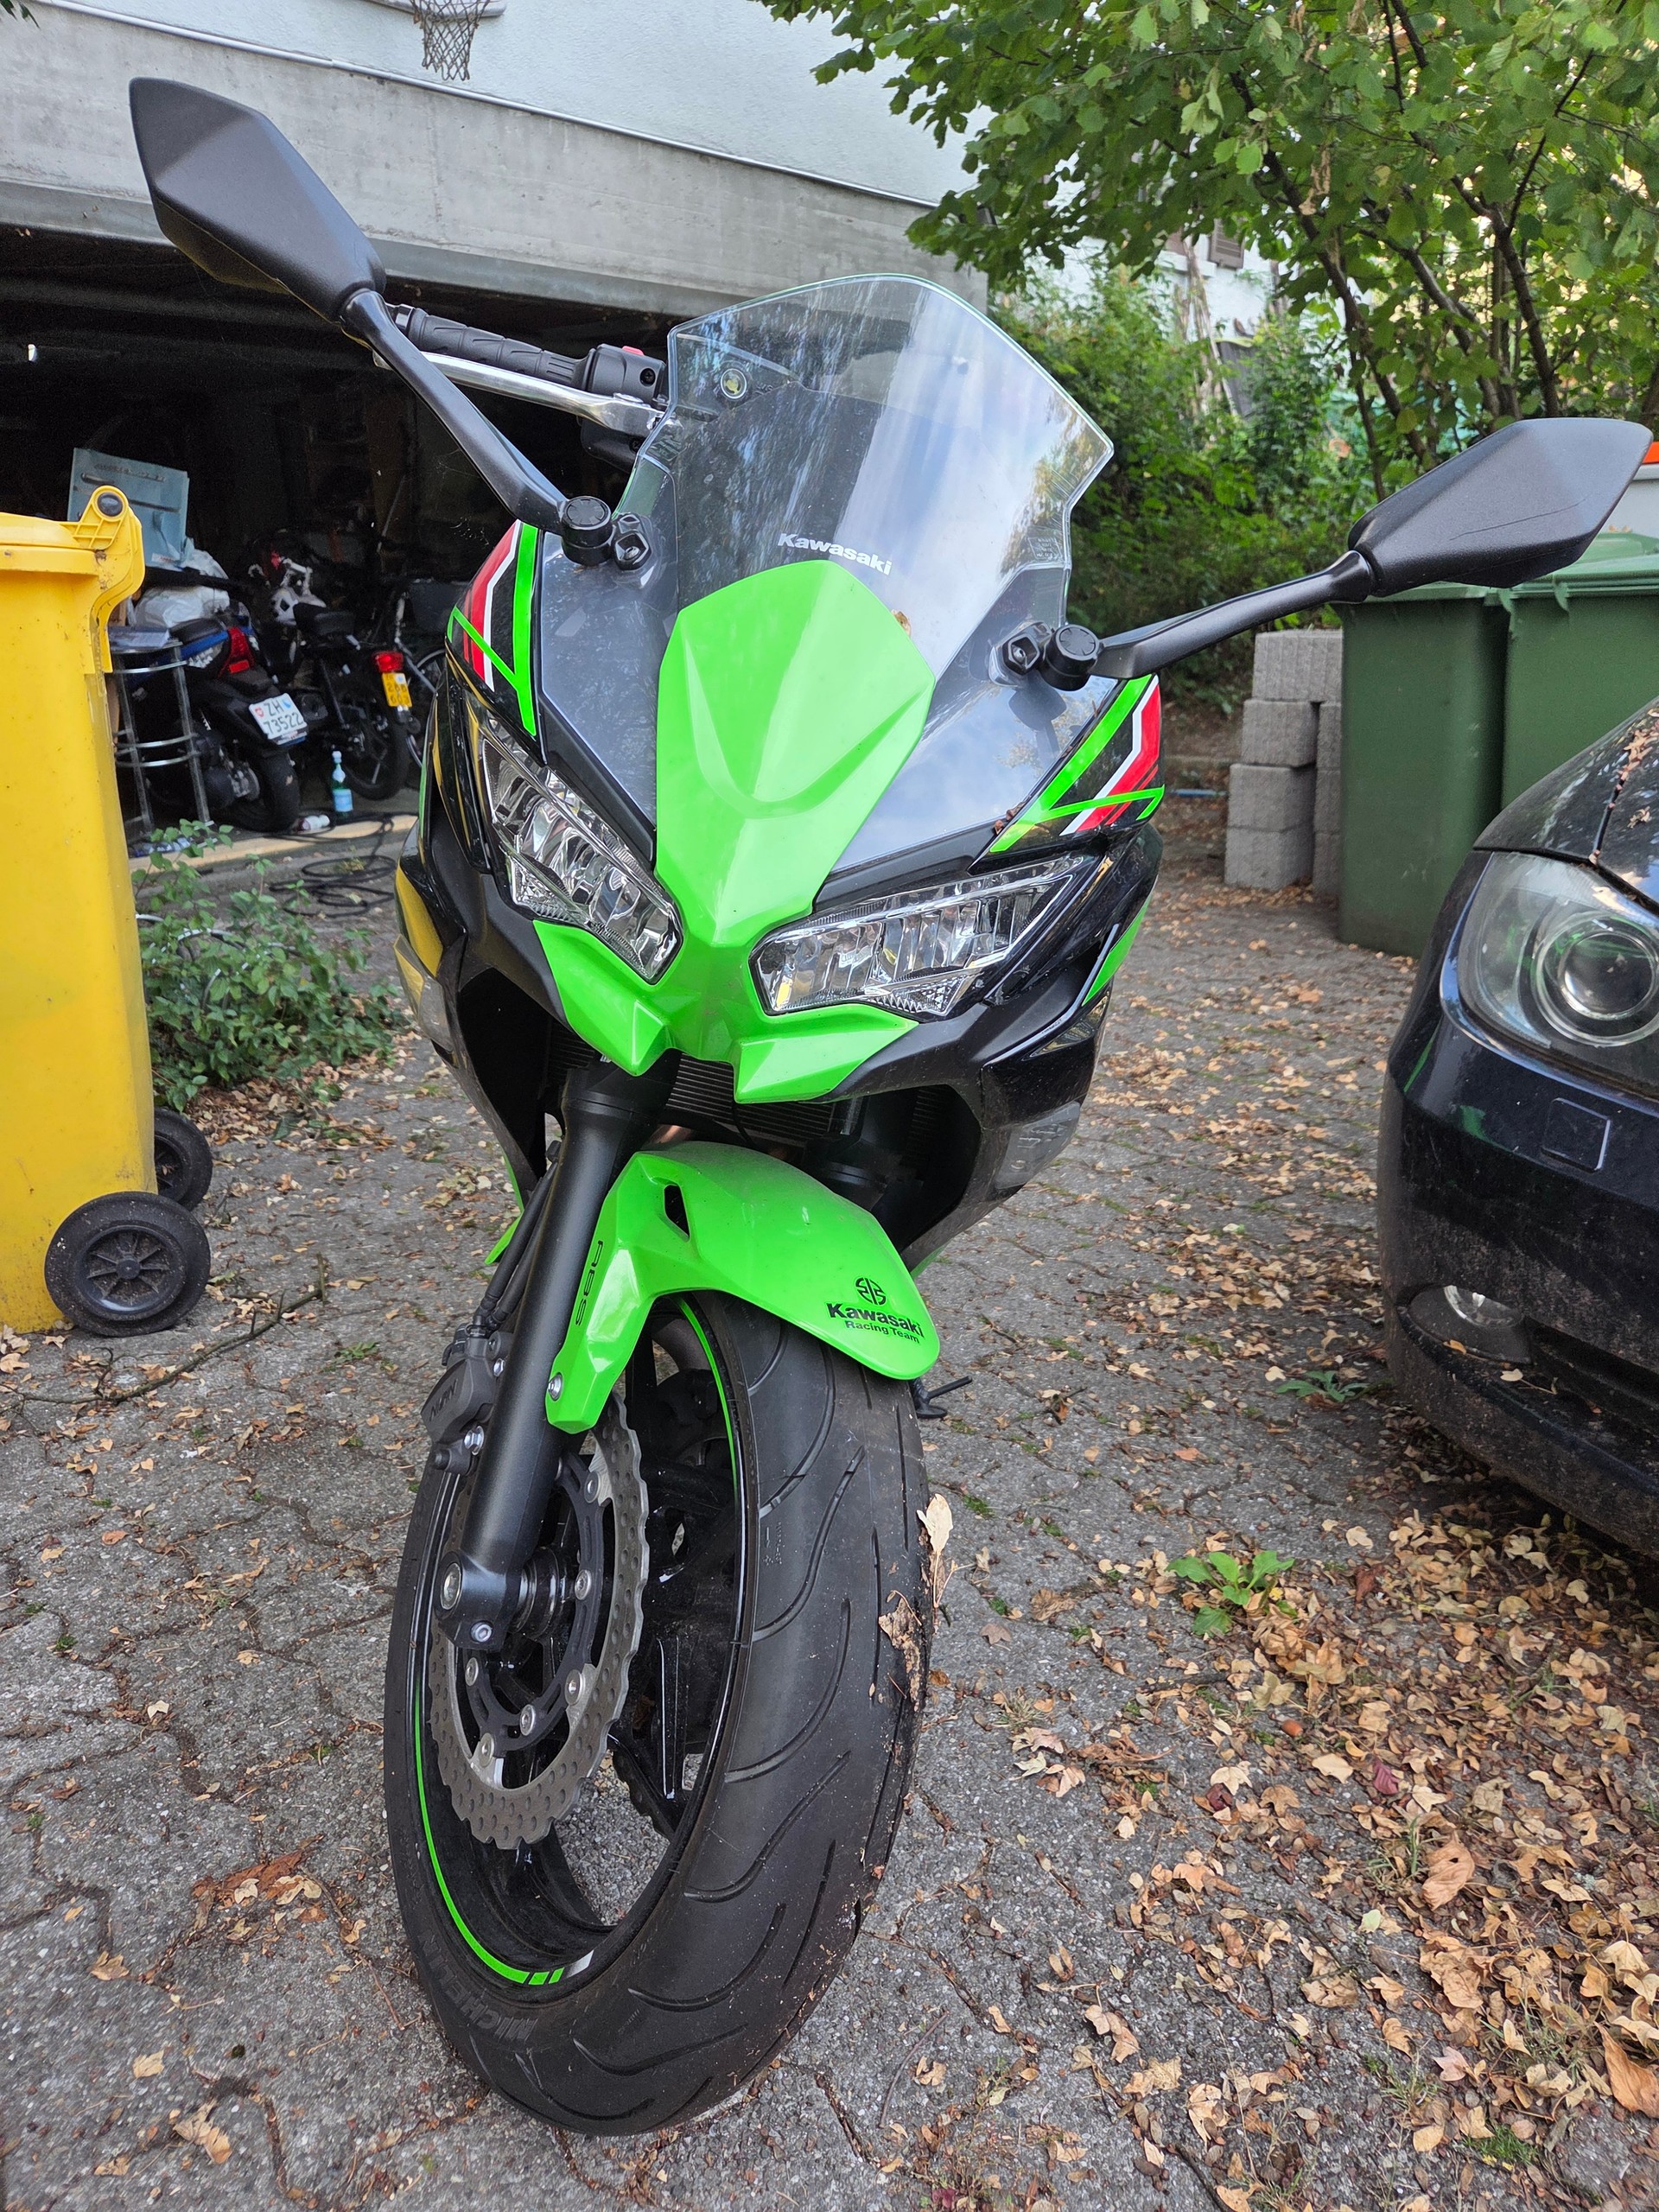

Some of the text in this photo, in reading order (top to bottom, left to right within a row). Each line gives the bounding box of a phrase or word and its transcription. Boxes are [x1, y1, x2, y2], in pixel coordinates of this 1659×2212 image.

[778, 533, 892, 575] Kawasaki
[264, 699, 285, 716] ZH
[263, 712, 303, 734] 73522
[575, 1240, 604, 1326] ABS
[826, 1302, 925, 1338] Kawasaki
[845, 1320, 920, 1344] Racing Team
